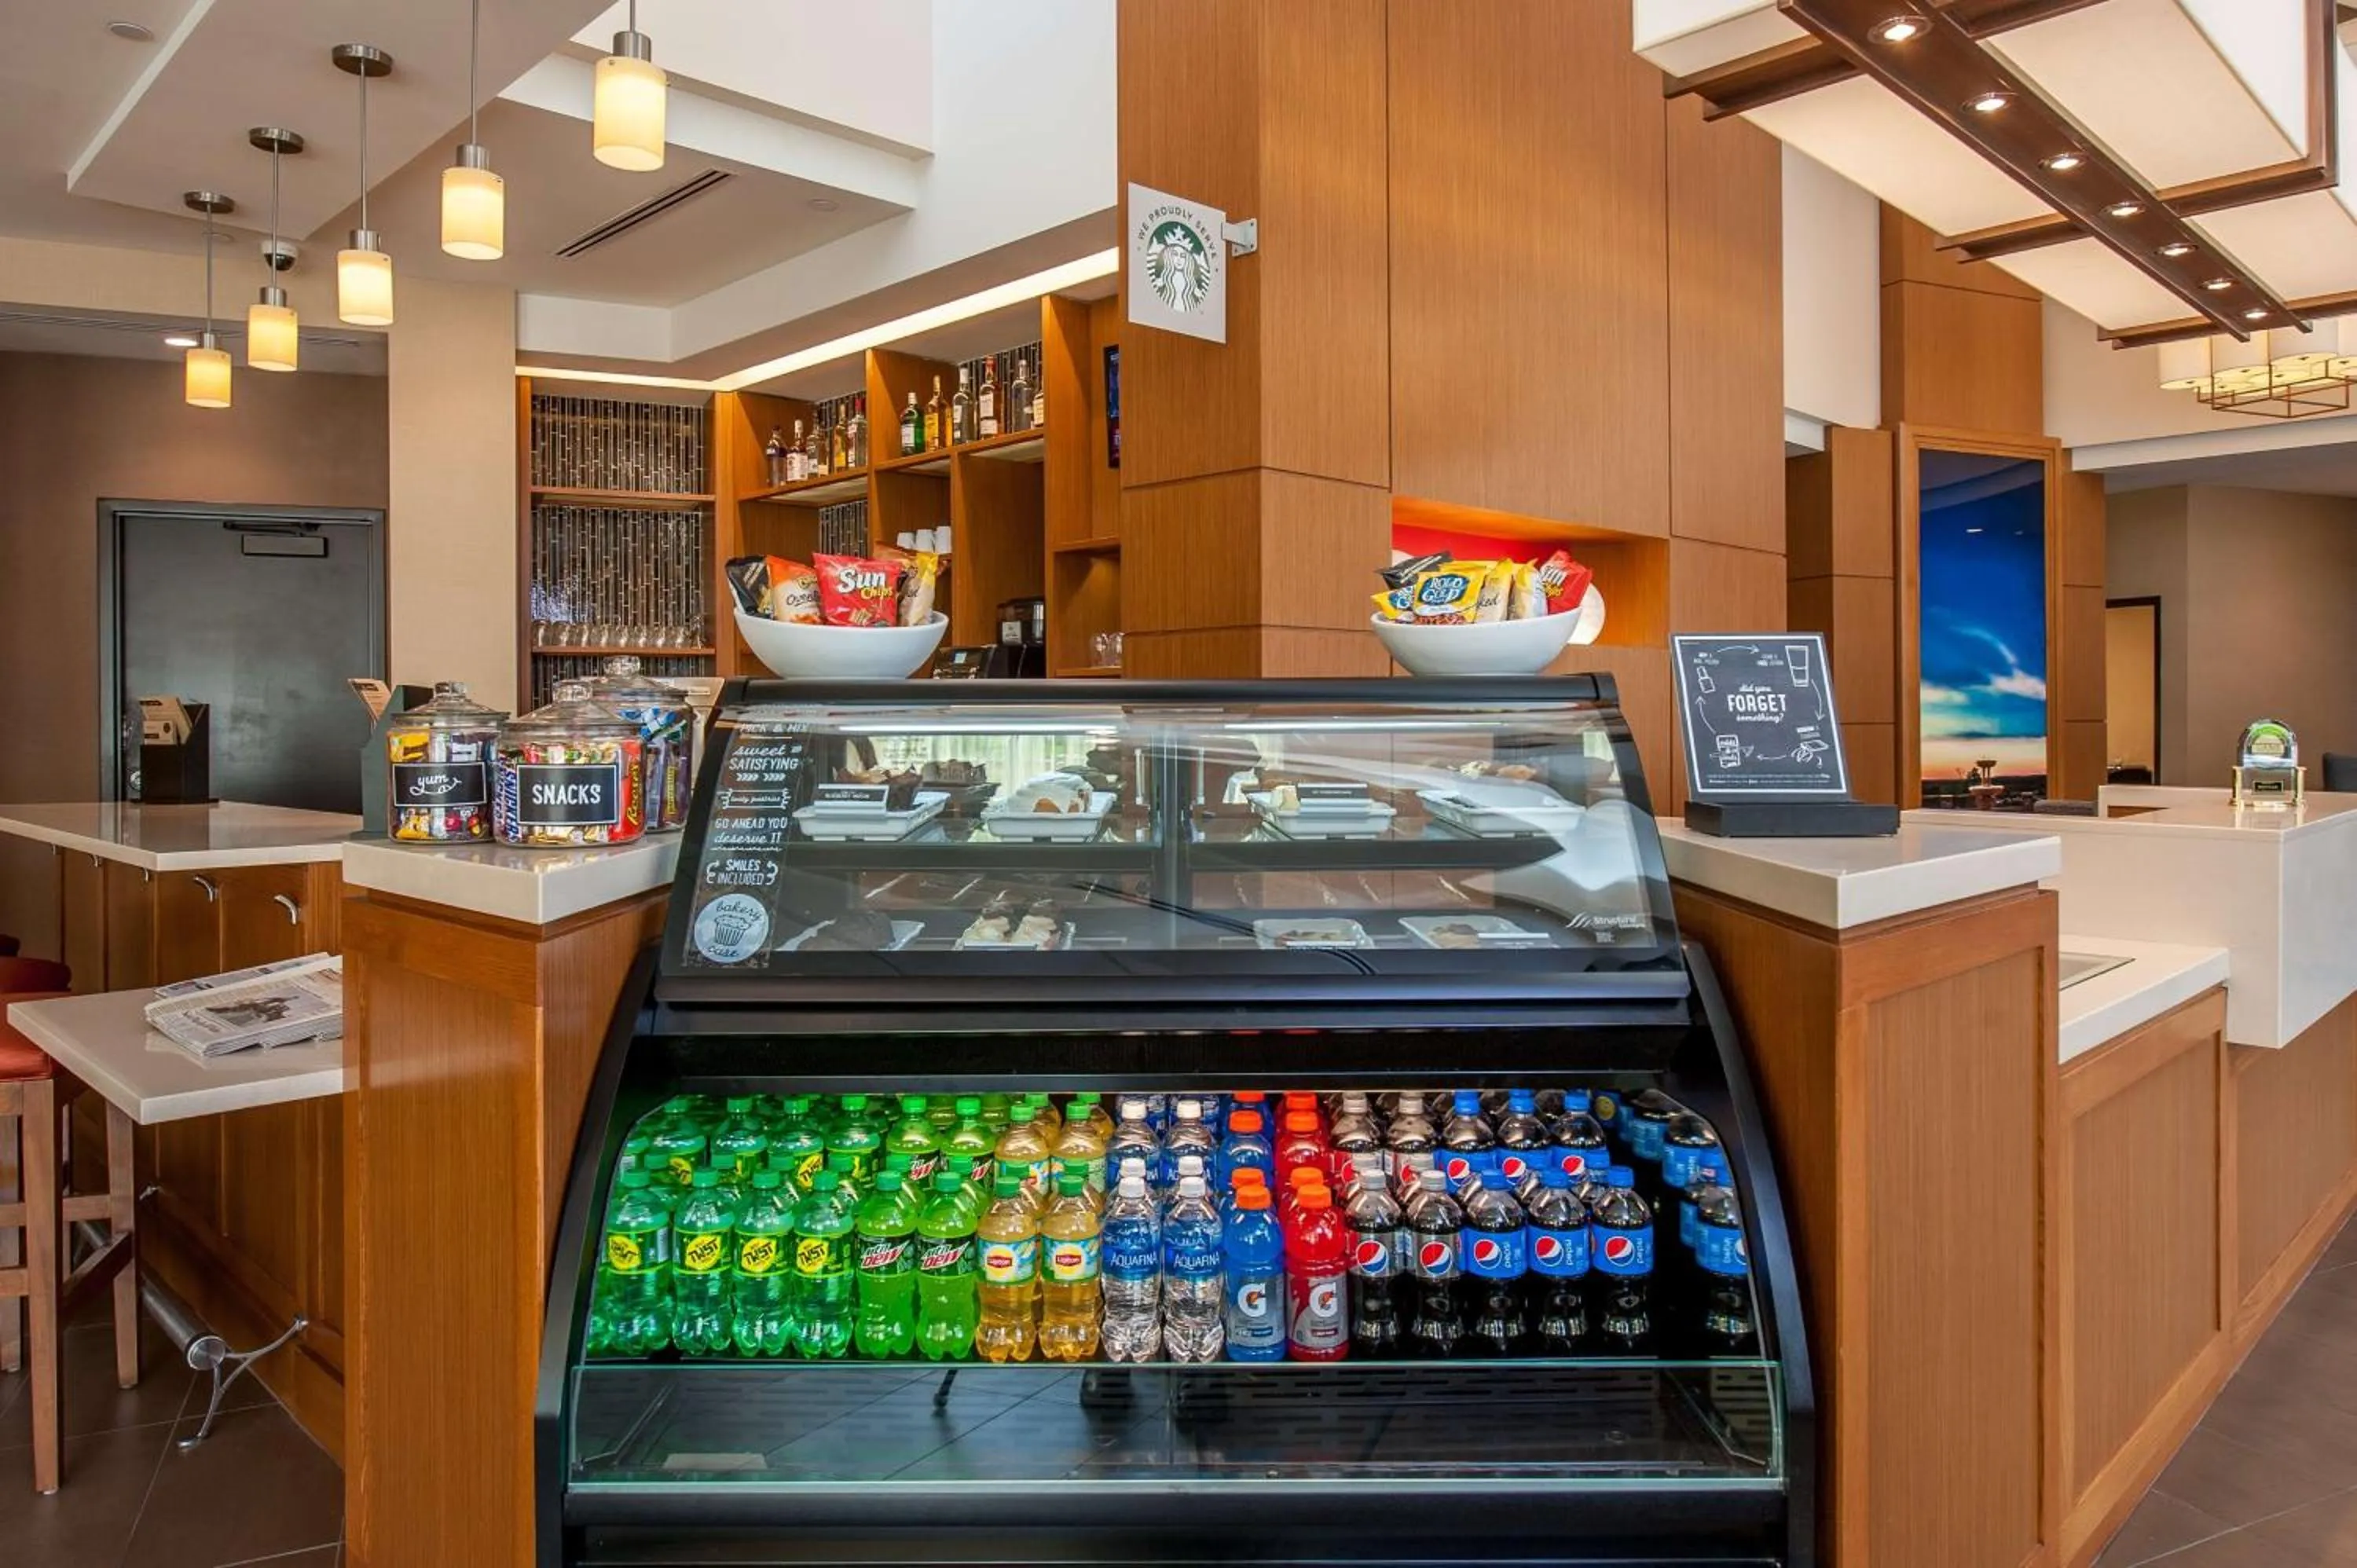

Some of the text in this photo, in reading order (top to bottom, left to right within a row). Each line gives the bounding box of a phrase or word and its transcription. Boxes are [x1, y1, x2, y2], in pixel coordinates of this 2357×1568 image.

[1138, 206, 1217, 258] WE PROUDLY SERVE
[837, 566, 886, 594] Sun
[1727, 694, 1787, 713] FORGET
[1736, 713, 1785, 724] something?
[728, 757, 800, 771] SATISFYING
[532, 783, 602, 806] SNACKS
[715, 817, 788, 829] GO AHEAD YOU
[714, 832, 782, 844] deserve IT
[725, 858, 761, 871] SMILES
[717, 871, 764, 885] INCLUDED
[716, 899, 762, 922] bakery
[708, 945, 739, 957] case
[1110, 1251, 1158, 1269] AQUAFINA
[1173, 1250, 1220, 1269] AQUAFINA
[1503, 1241, 1512, 1269] pepsi
[1637, 1237, 1645, 1264] pepsi
[1237, 1283, 1266, 1317] G
[1310, 1282, 1338, 1317] G
